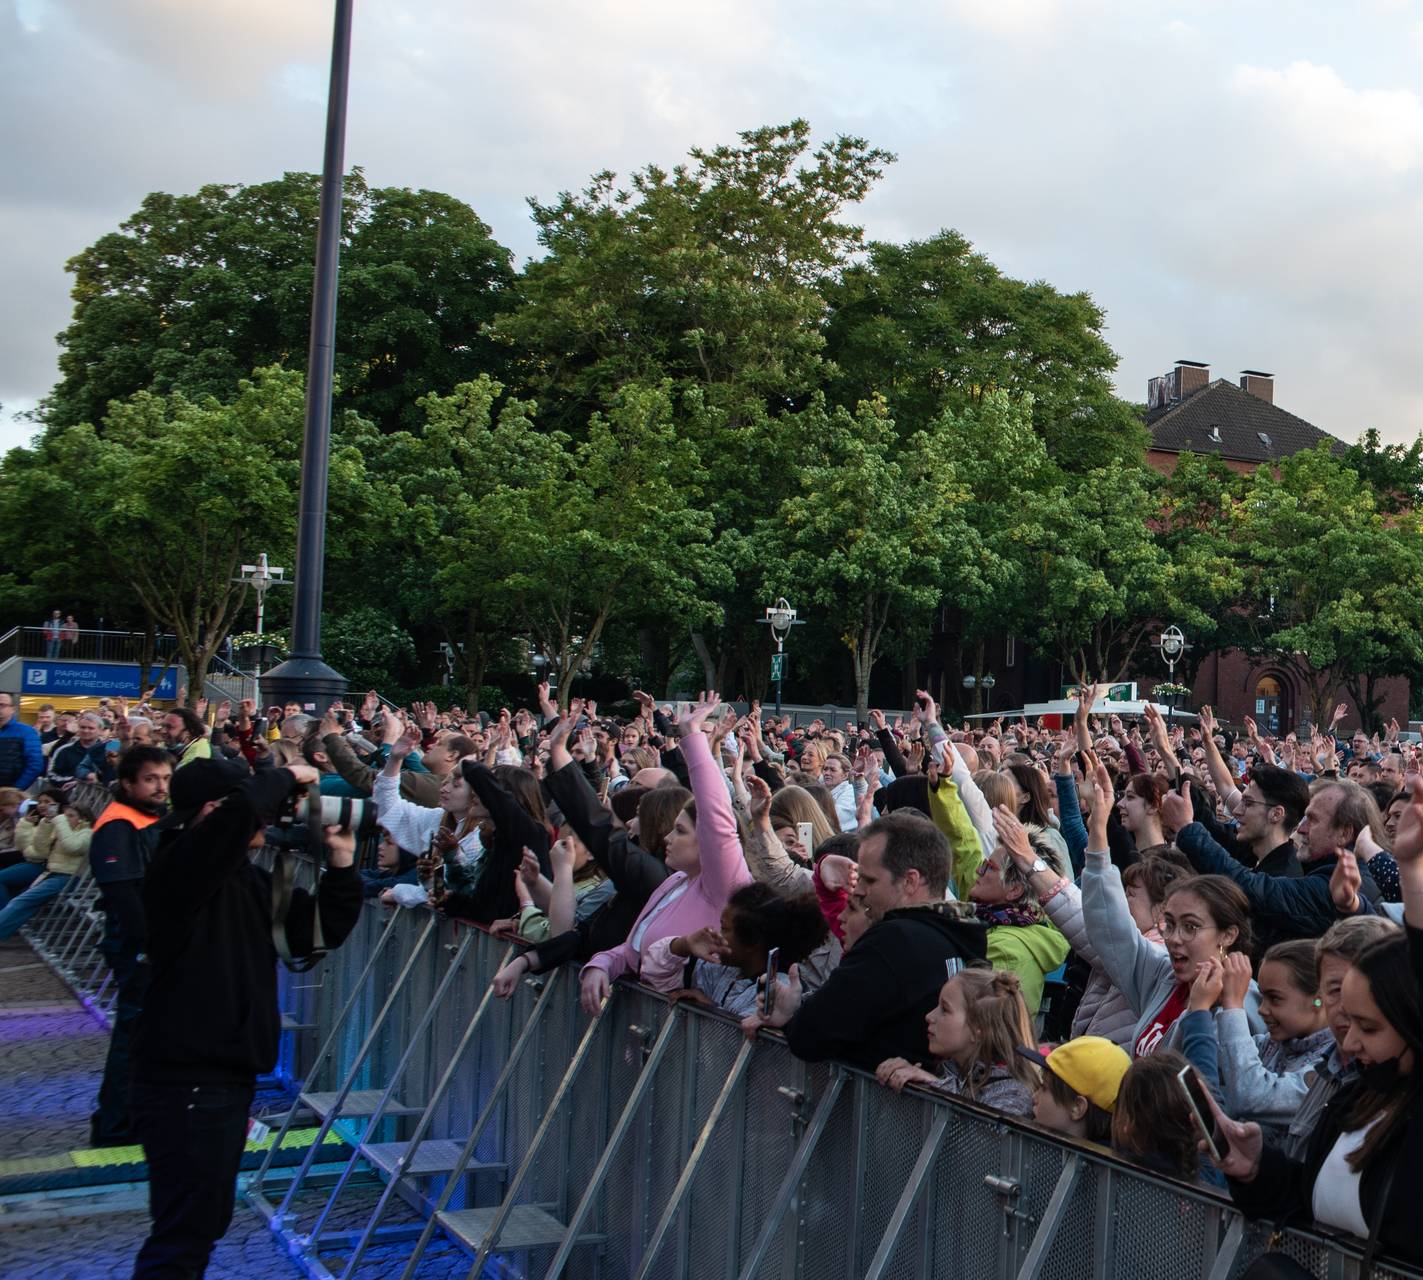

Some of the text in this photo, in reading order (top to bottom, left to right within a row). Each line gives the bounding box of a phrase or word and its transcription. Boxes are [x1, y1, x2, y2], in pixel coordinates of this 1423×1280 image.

[54, 669, 97, 679] PARKEN
[54, 679, 141, 690] AM FRIEDENSPL
